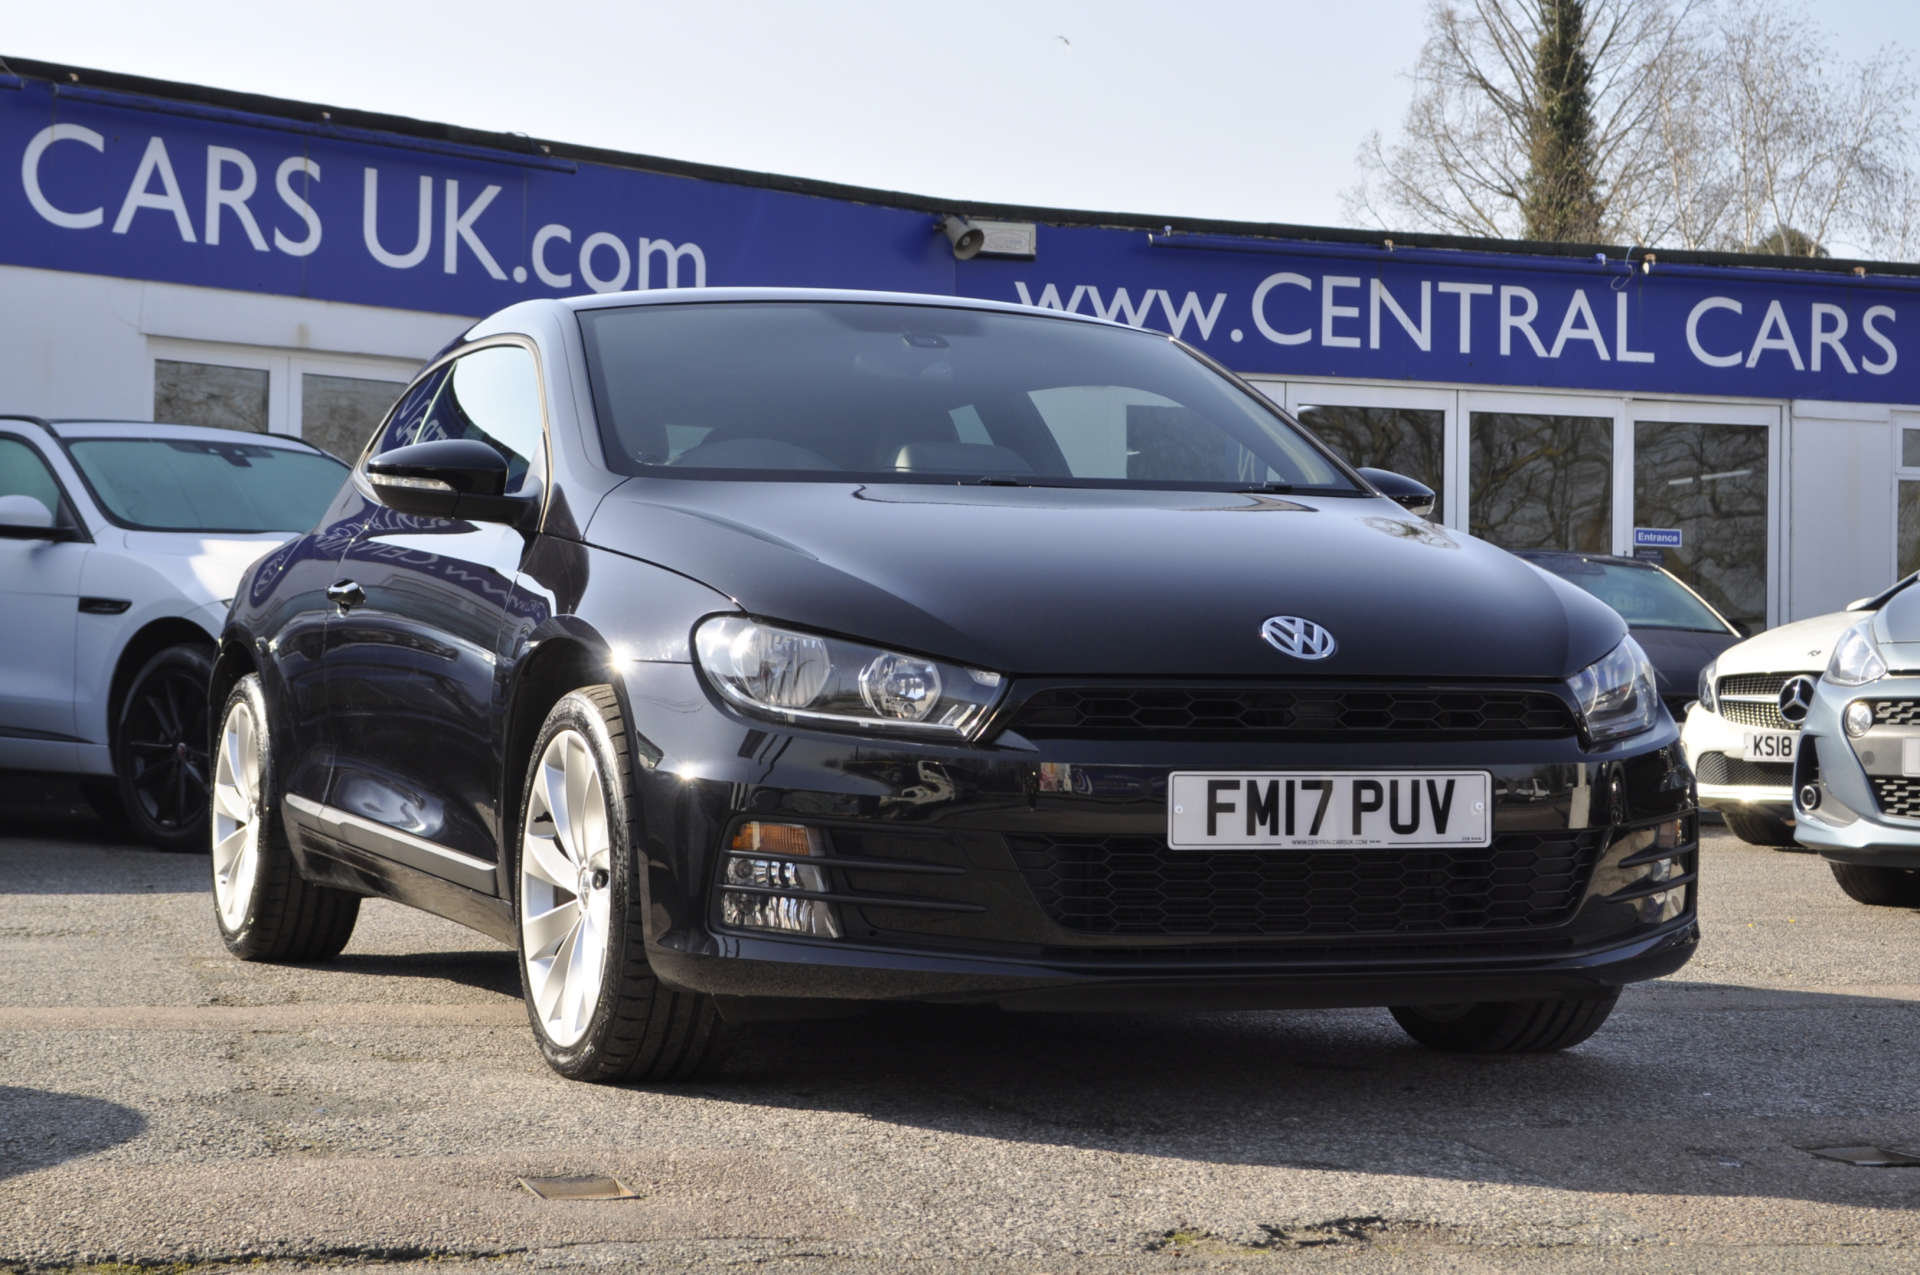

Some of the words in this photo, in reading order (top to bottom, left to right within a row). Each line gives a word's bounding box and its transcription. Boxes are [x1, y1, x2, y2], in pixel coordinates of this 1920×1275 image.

[21, 123, 323, 257] CARS
[362, 167, 708, 293] UK.com
[1685, 296, 1898, 376] CARS
[1638, 532, 1678, 543] Entrance
[1753, 736, 1793, 757] KS18
[1206, 779, 1334, 837] FM17
[1351, 778, 1456, 836] PUV
